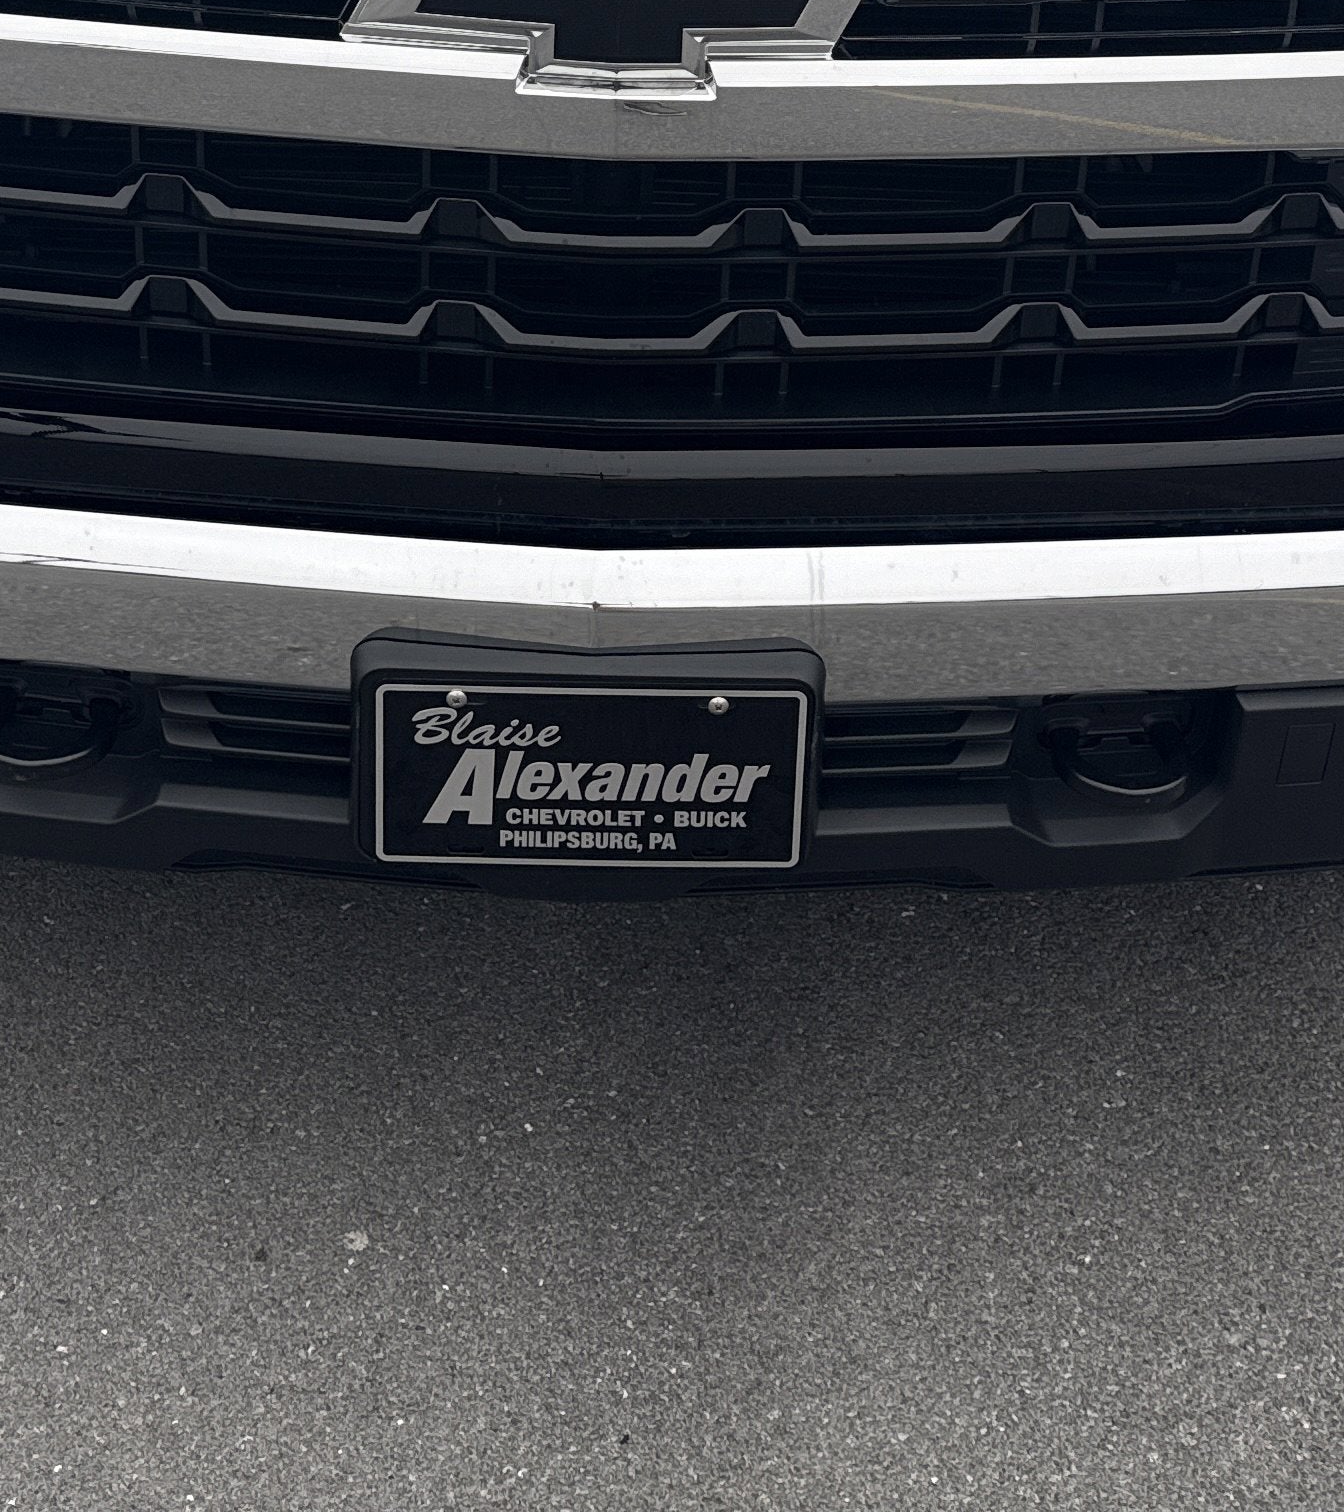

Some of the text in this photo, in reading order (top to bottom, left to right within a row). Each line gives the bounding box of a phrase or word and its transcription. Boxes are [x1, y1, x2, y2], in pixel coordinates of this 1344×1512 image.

[411, 706, 561, 748] Blaise
[422, 748, 771, 825] Alexander
[505, 807, 747, 828] CHEVROLET BUICK
[499, 829, 677, 853] PHILIPSBURG, PA
